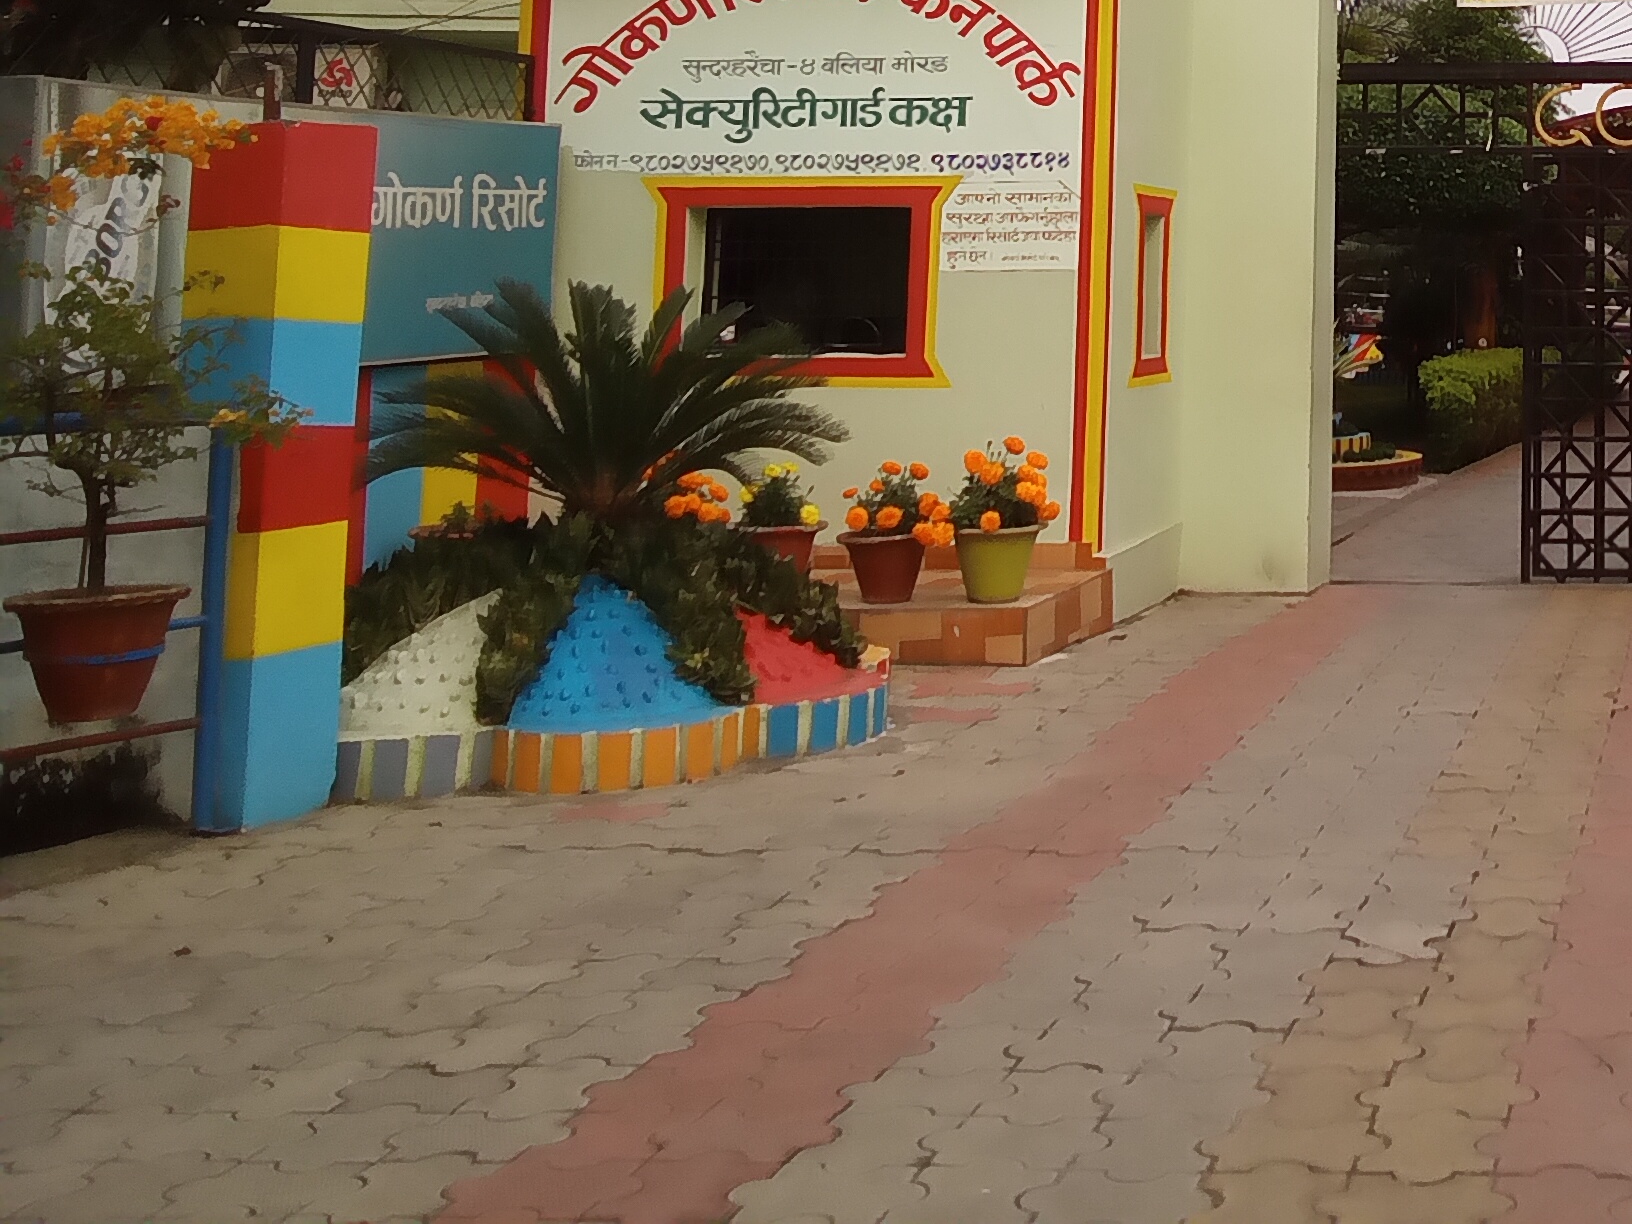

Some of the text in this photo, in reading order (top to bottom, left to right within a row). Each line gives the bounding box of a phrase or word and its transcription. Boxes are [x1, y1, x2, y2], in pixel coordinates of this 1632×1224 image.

[983, 14, 1082, 106] पार्क
[888, 96, 973, 133] कक्ष
[371, 172, 547, 232] गोकर्ण रिसोर्ट
